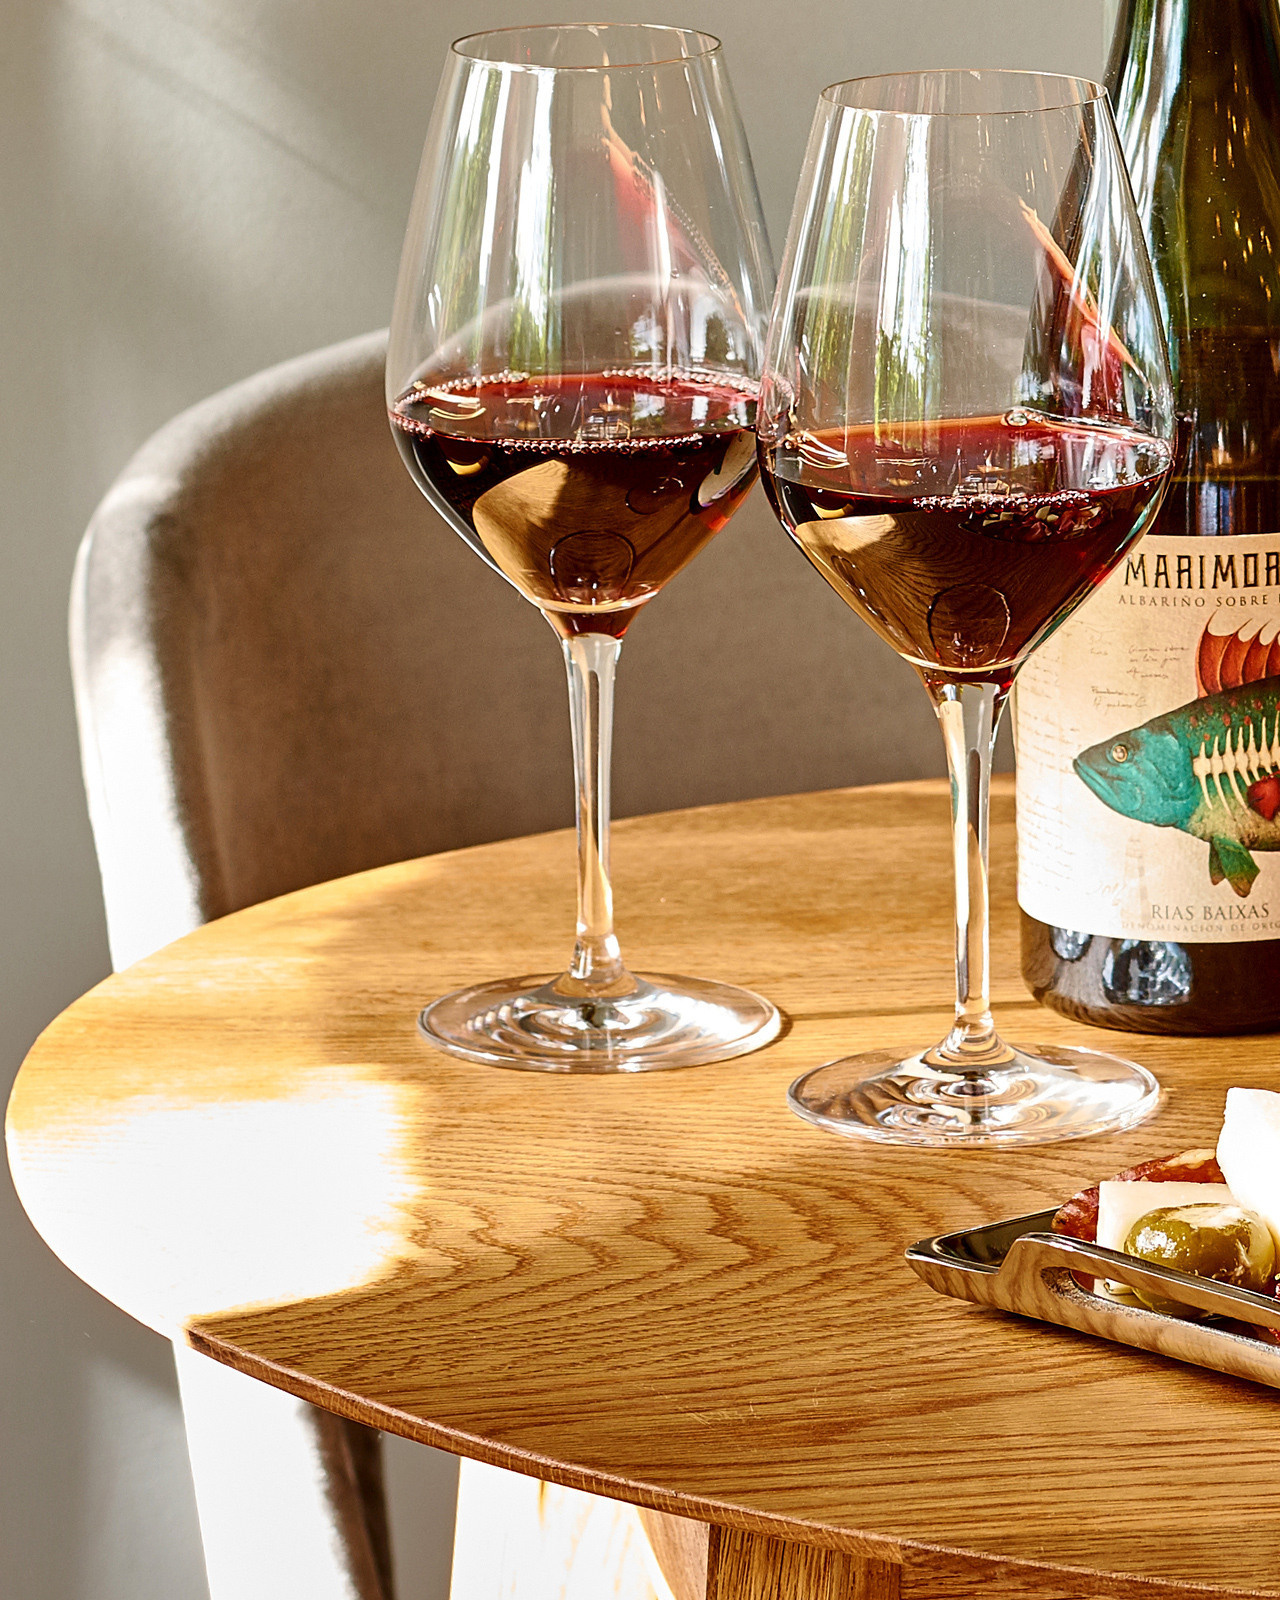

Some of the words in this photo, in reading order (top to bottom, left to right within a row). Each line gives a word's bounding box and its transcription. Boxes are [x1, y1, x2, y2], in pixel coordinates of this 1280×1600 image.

[1118, 594, 1206, 608] ALBARIÑO
[1215, 594, 1269, 608] SOBRE
[1151, 904, 1195, 921] RIAS
[1202, 902, 1270, 921] BAIXAS
[1230, 922, 1246, 933] DE
